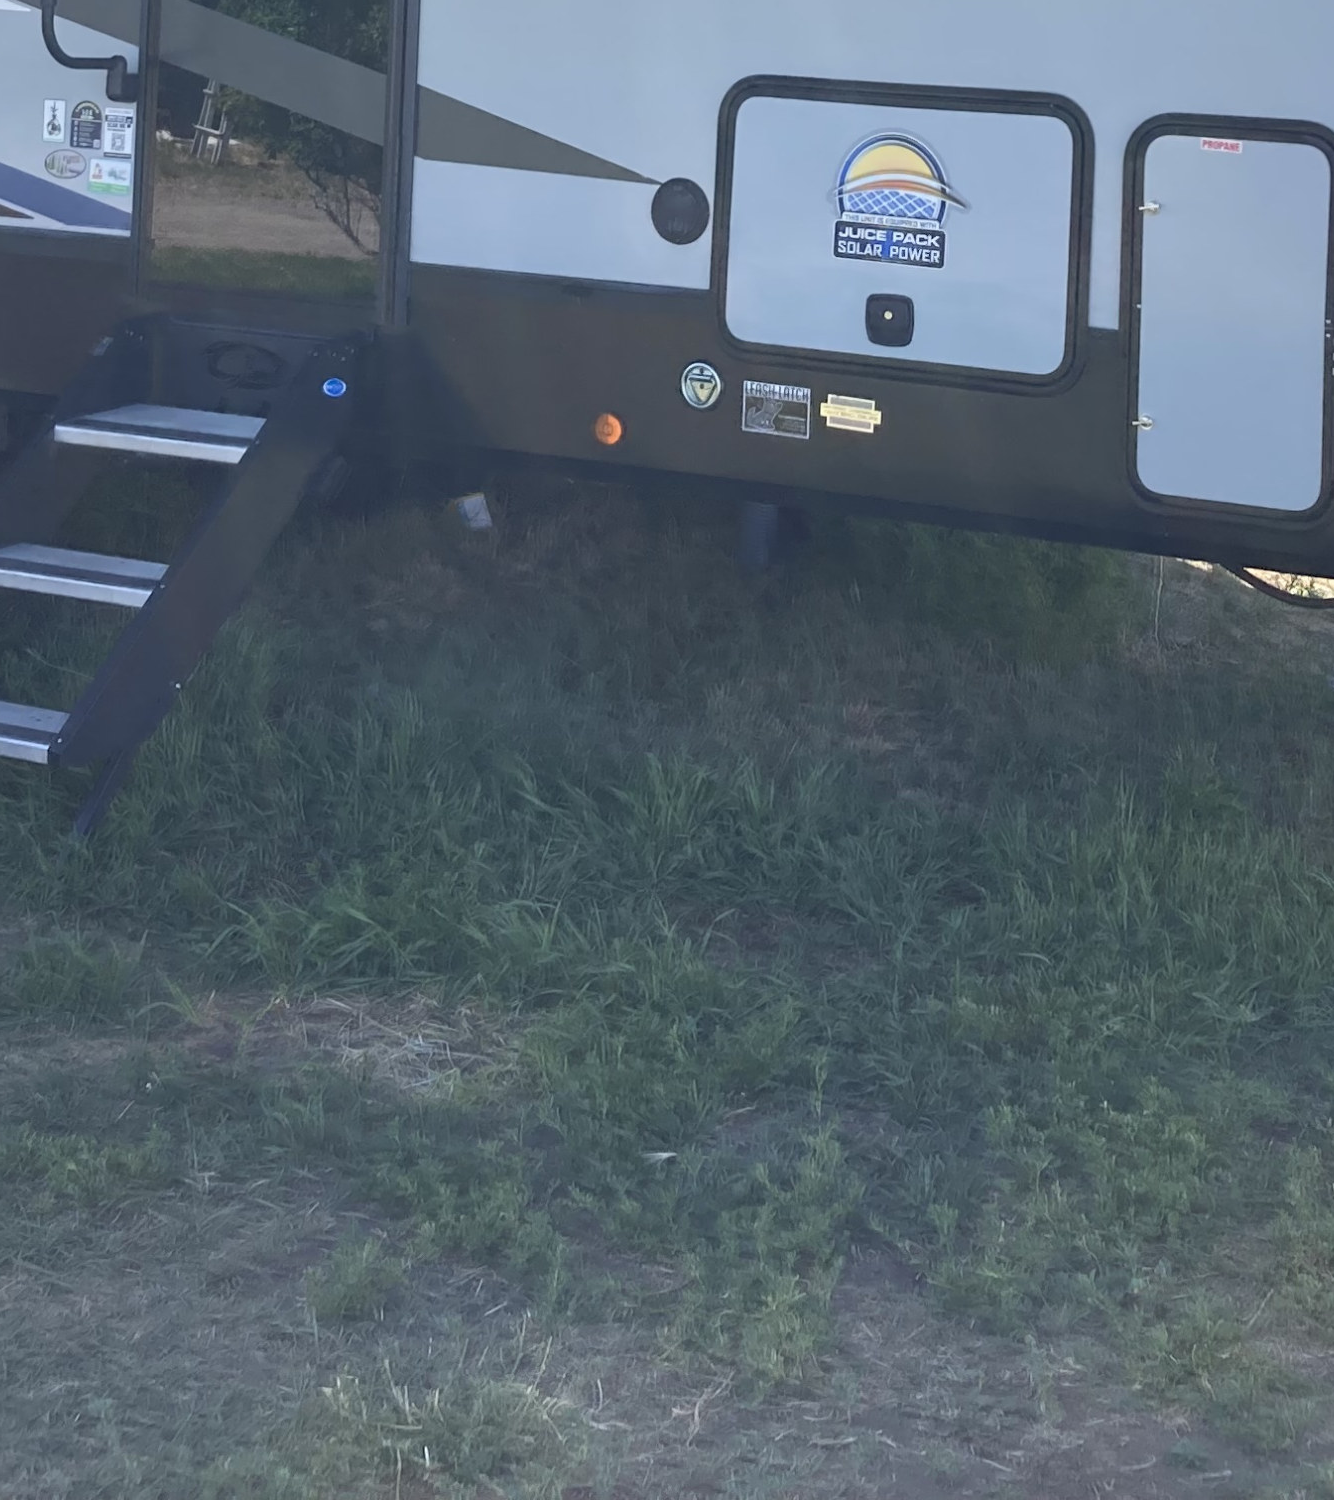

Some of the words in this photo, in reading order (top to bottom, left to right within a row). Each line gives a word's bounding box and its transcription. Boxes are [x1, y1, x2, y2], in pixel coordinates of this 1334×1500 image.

[1201, 139, 1240, 152] PROPANE
[838, 226, 887, 242] JUICE
[892, 231, 940, 247] PACK
[837, 240, 883, 257] SOLAR
[890, 246, 941, 263] POWER
